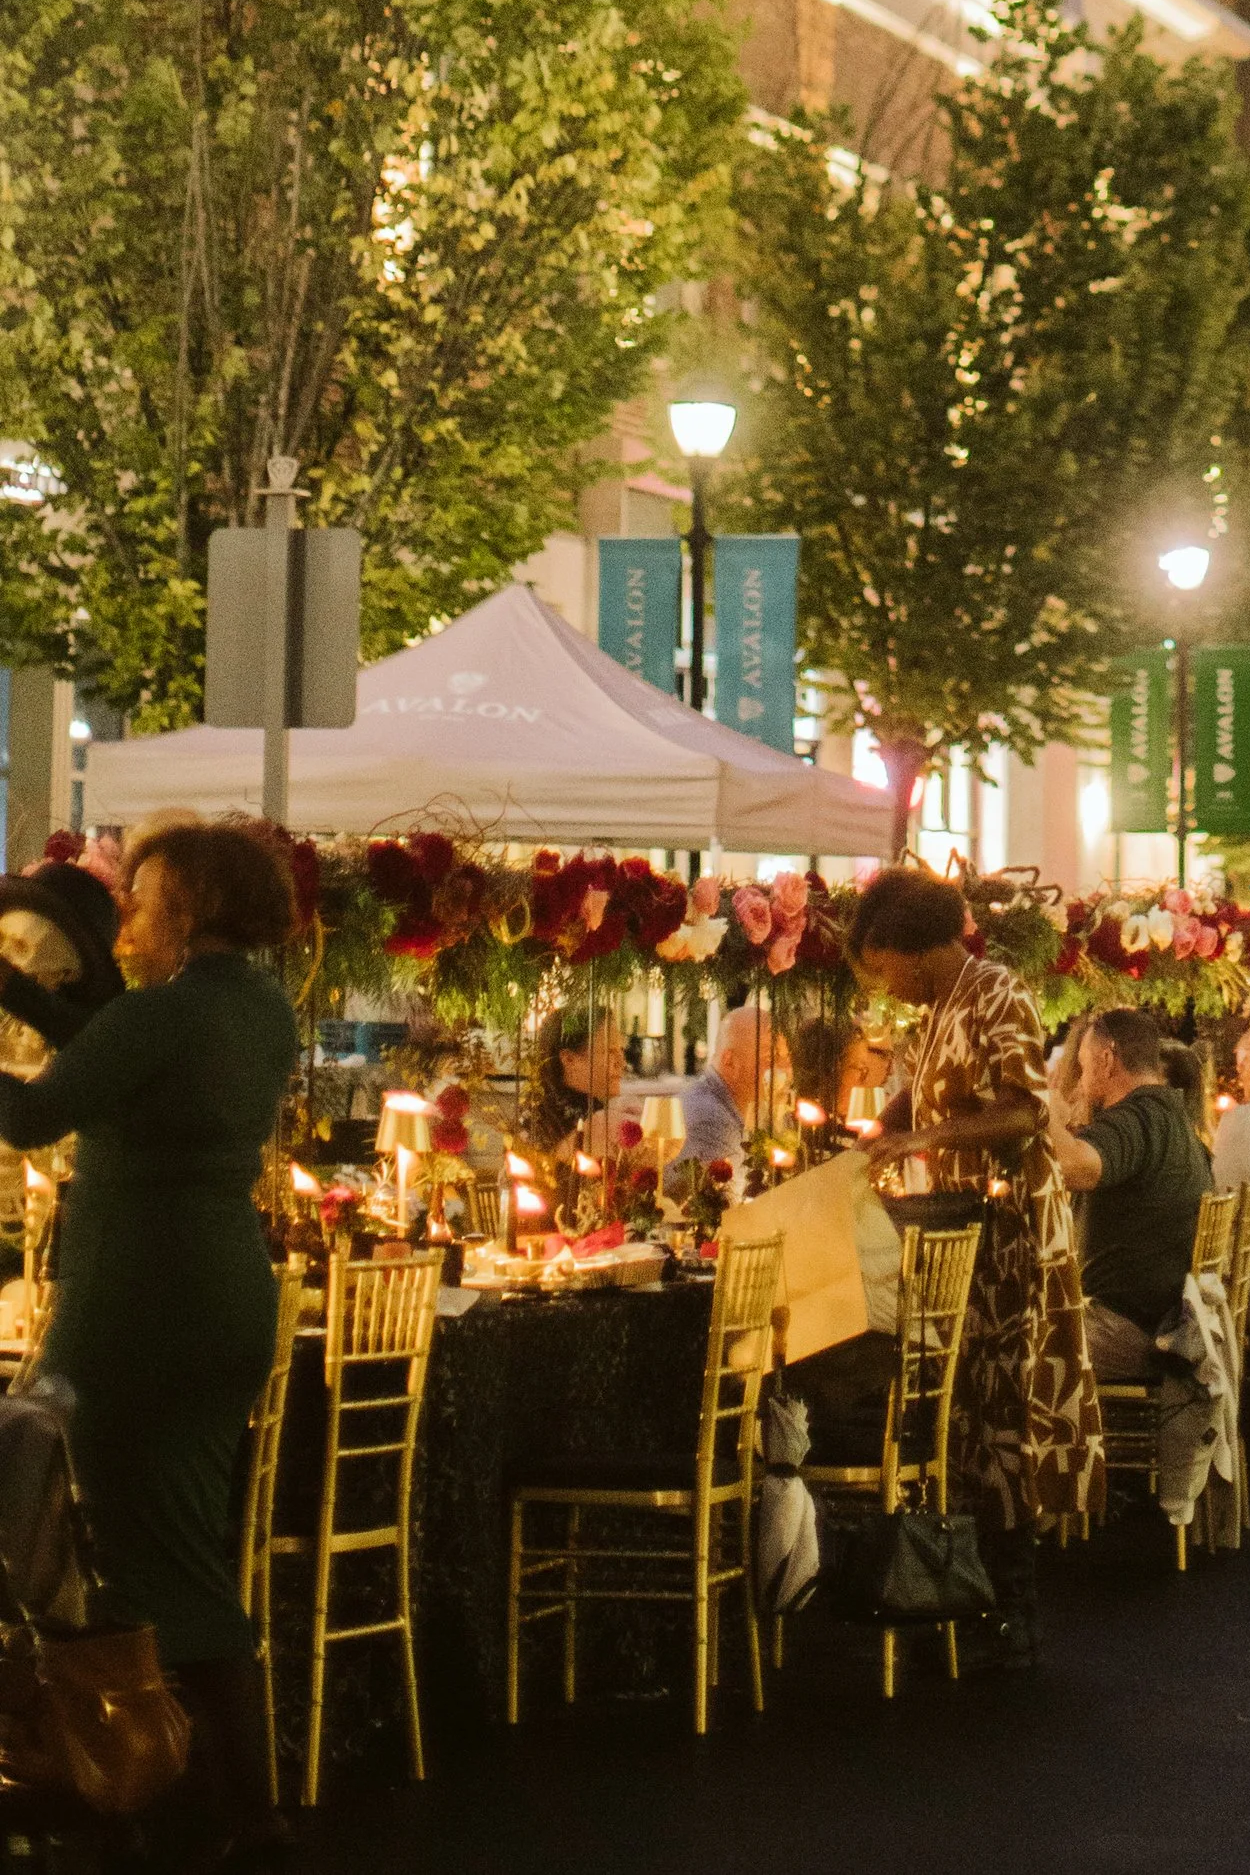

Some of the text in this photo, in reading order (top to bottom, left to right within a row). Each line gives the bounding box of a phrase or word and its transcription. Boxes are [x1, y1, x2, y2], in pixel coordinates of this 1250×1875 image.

[742, 567, 763, 688] AVALON
[360, 697, 541, 723] AVALON
[1216, 668, 1235, 760] AVALON
